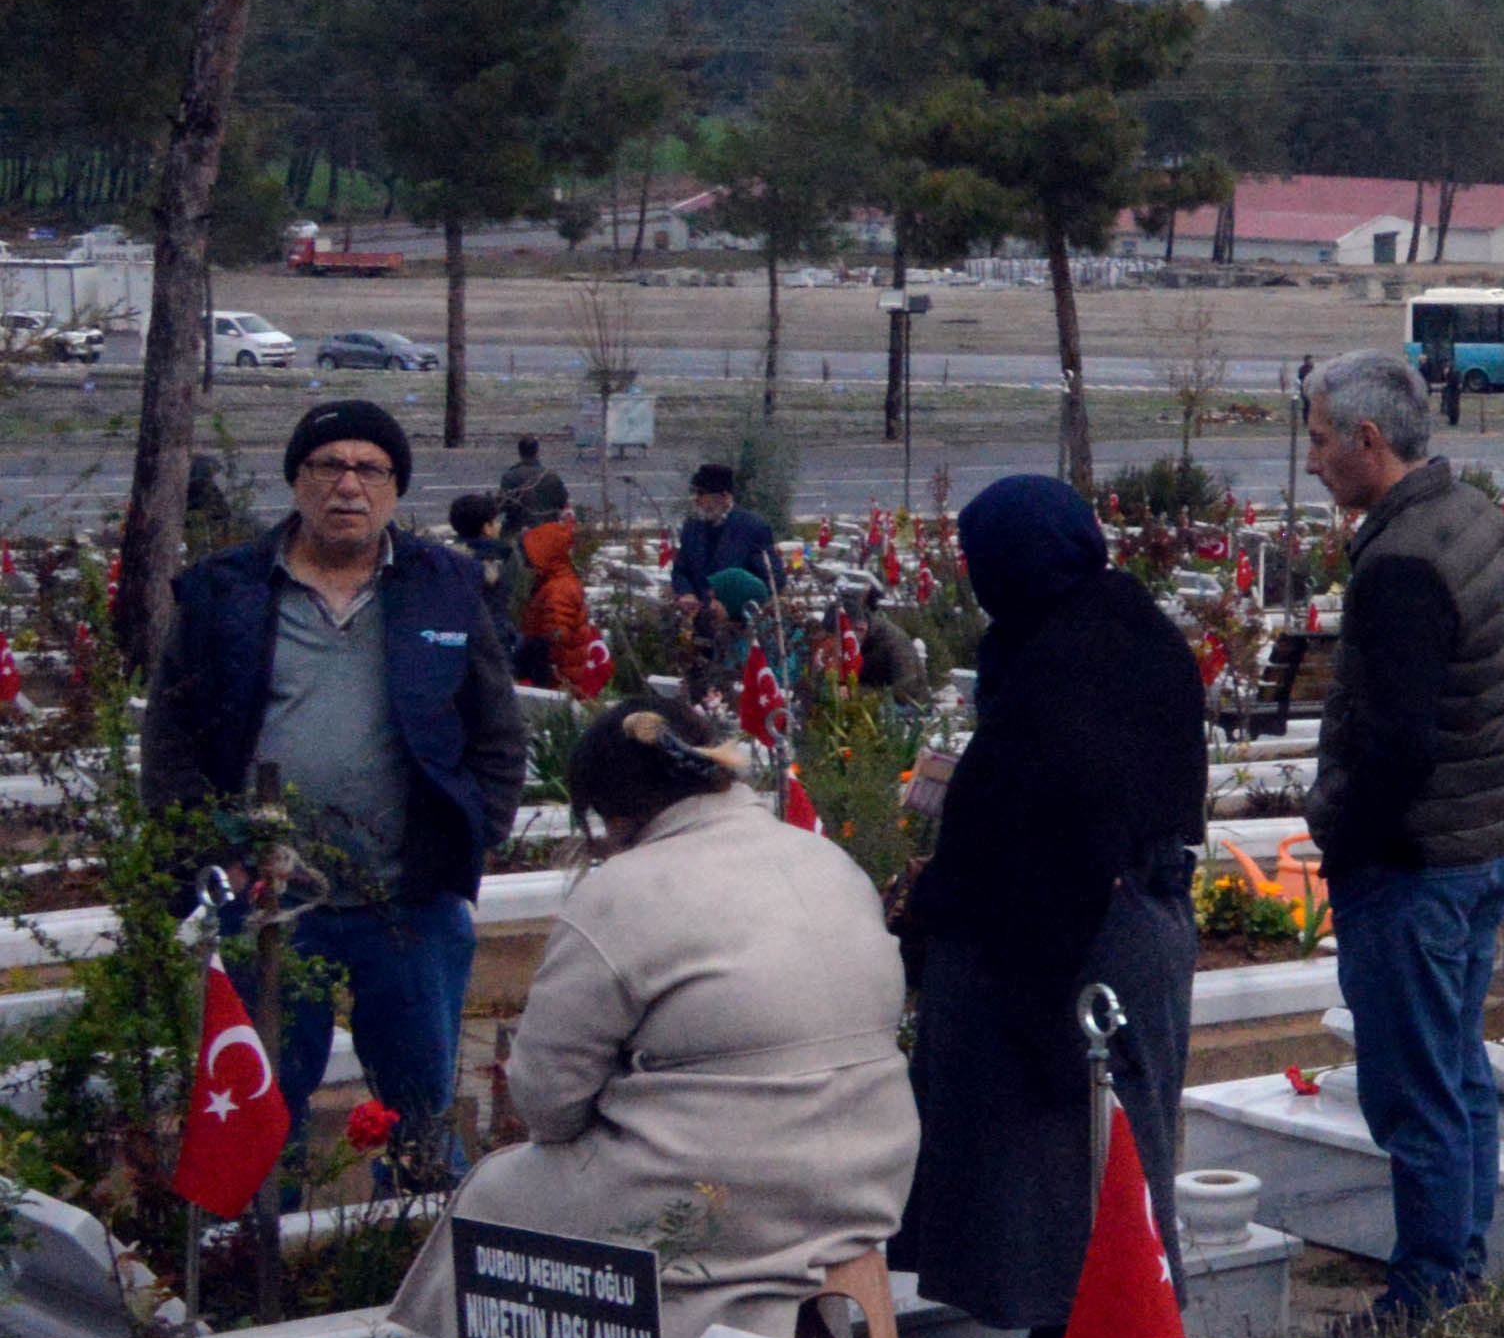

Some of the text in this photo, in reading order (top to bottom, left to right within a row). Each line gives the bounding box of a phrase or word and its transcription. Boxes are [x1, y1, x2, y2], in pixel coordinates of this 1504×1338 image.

[475, 1245, 636, 1307] DURDU MEHMET OĞLU
